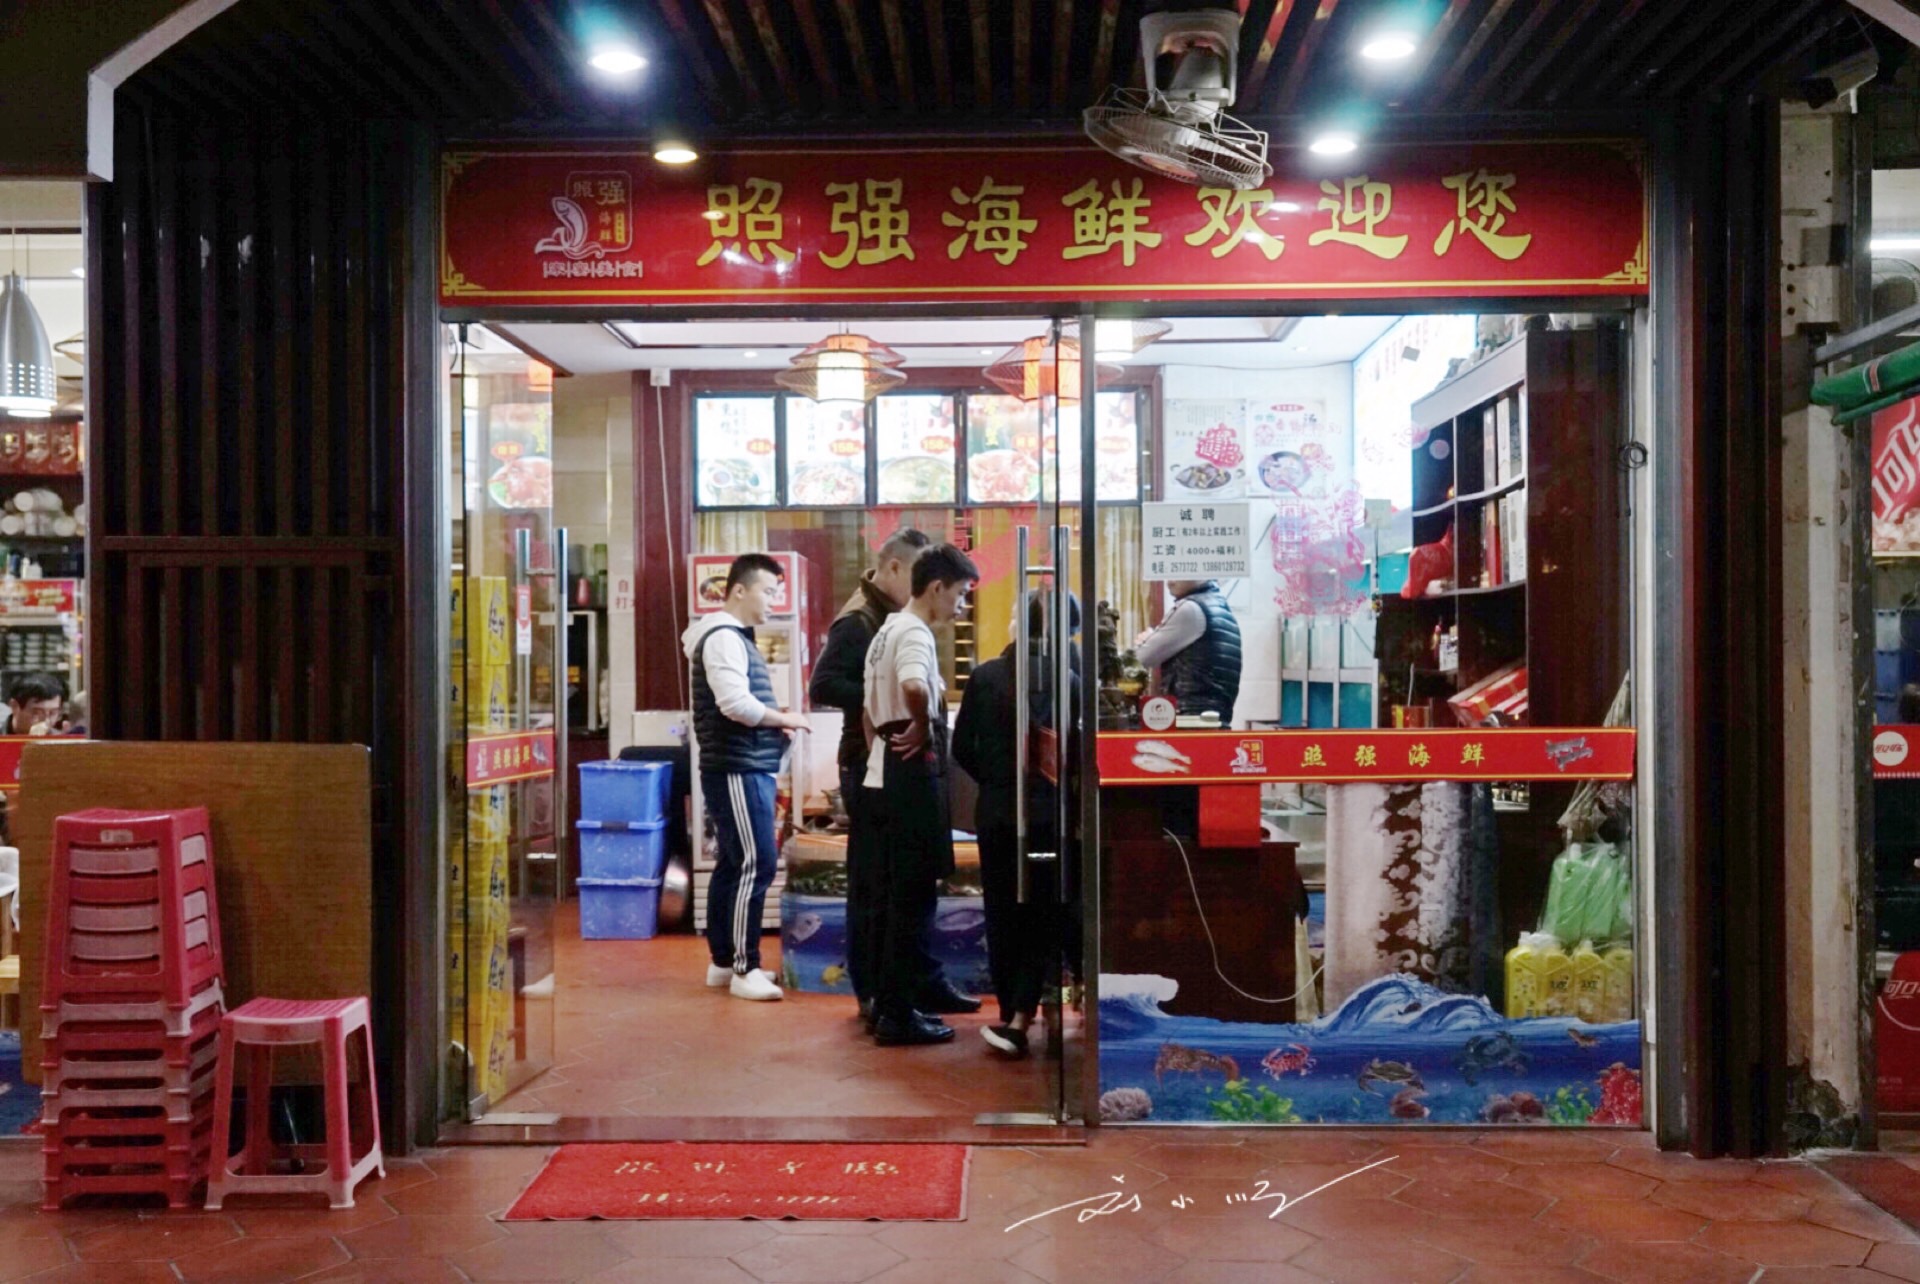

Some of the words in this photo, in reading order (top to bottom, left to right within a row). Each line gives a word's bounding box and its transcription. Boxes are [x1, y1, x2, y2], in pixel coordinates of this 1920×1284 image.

[696, 173, 1533, 269] 照强海鲜欢迎您
[1180, 508, 1216, 521] 诚聘
[1300, 742, 1486, 769] 照强海鲜
[1885, 979, 1920, 999] 可口
